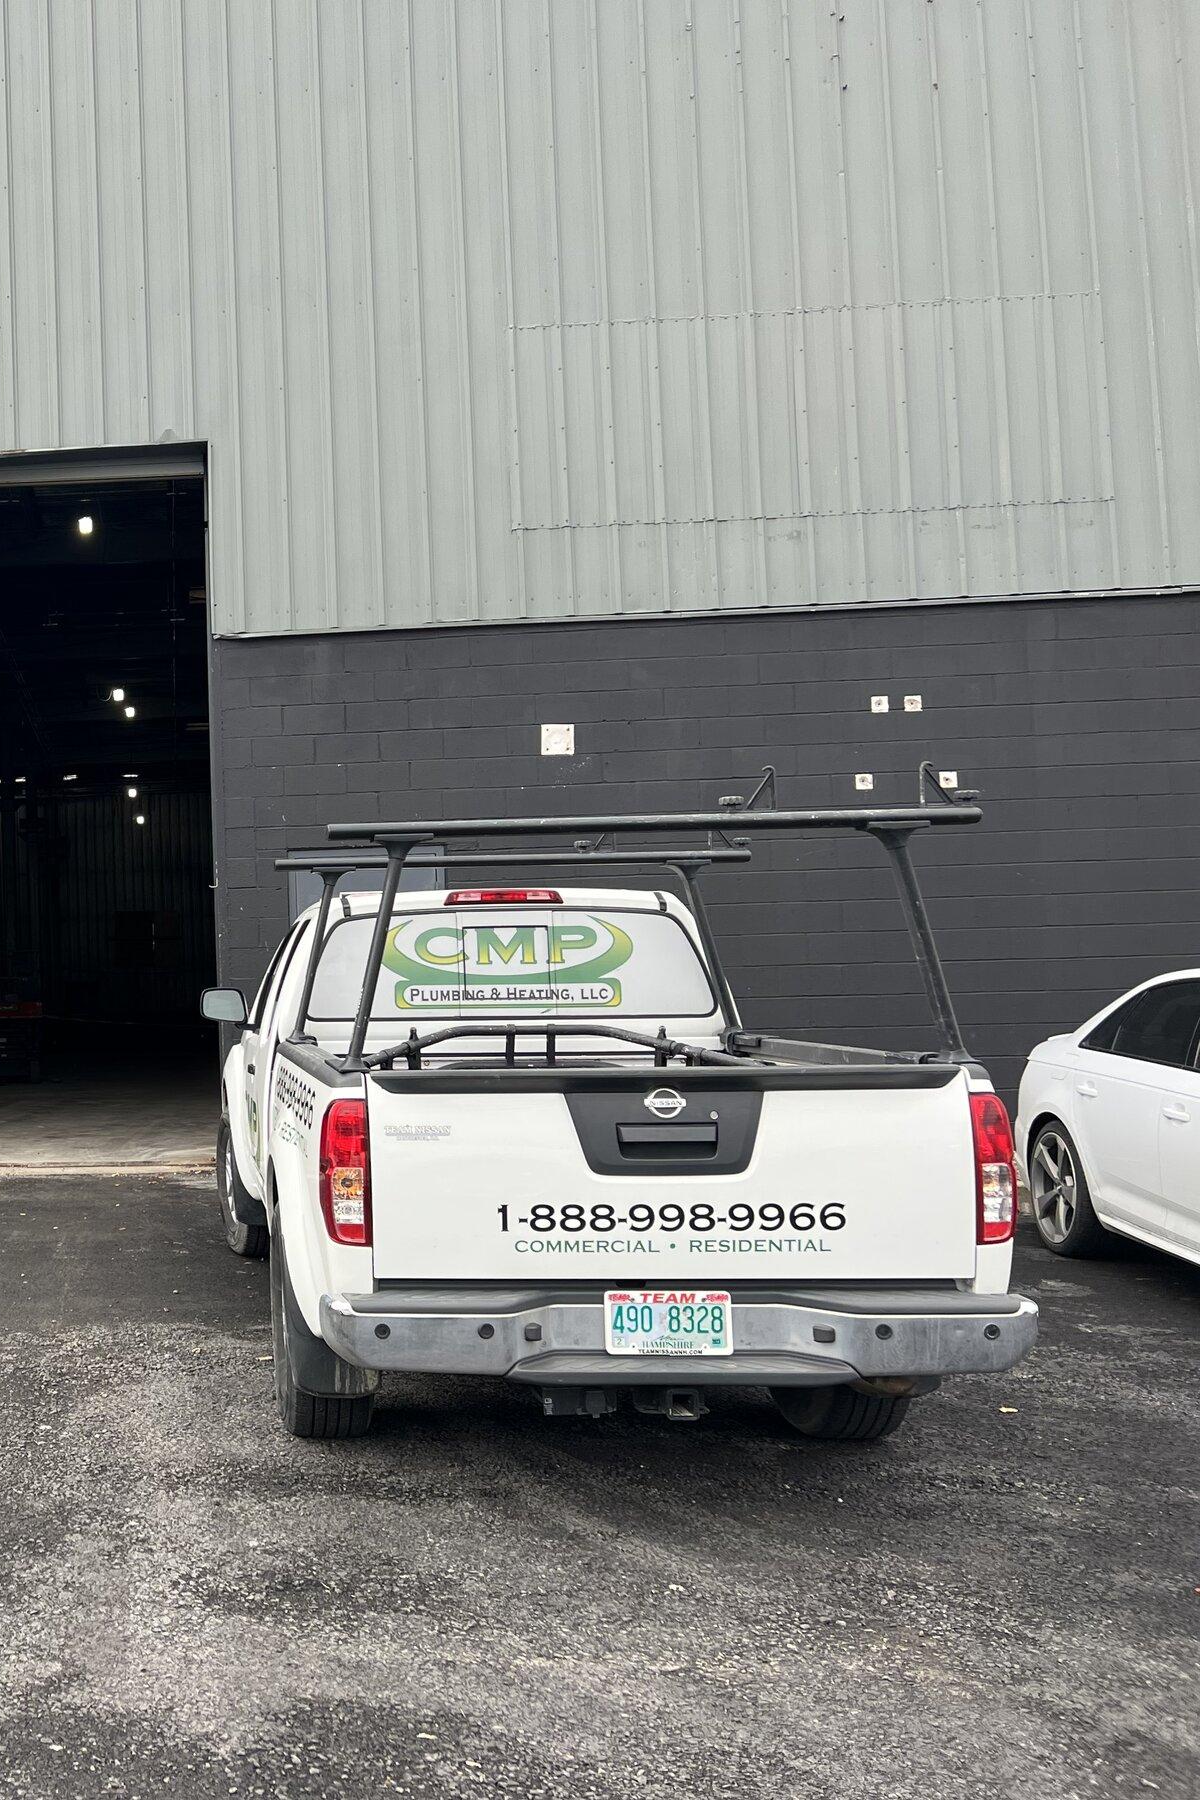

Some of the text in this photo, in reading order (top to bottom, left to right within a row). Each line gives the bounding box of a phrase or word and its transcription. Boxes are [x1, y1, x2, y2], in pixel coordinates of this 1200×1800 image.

[414, 925, 597, 965] CMP
[410, 987, 608, 1002] PLUMBING & HEATING, LLC
[497, 1202, 846, 1232] 1-888-998-9966
[514, 1239, 832, 1253] COMMERCIAL RESIDENTIAL
[640, 1293, 696, 1303] TEAM
[612, 1305, 723, 1333] 490 8328
[642, 1341, 694, 1350] HAMPSHIRE
